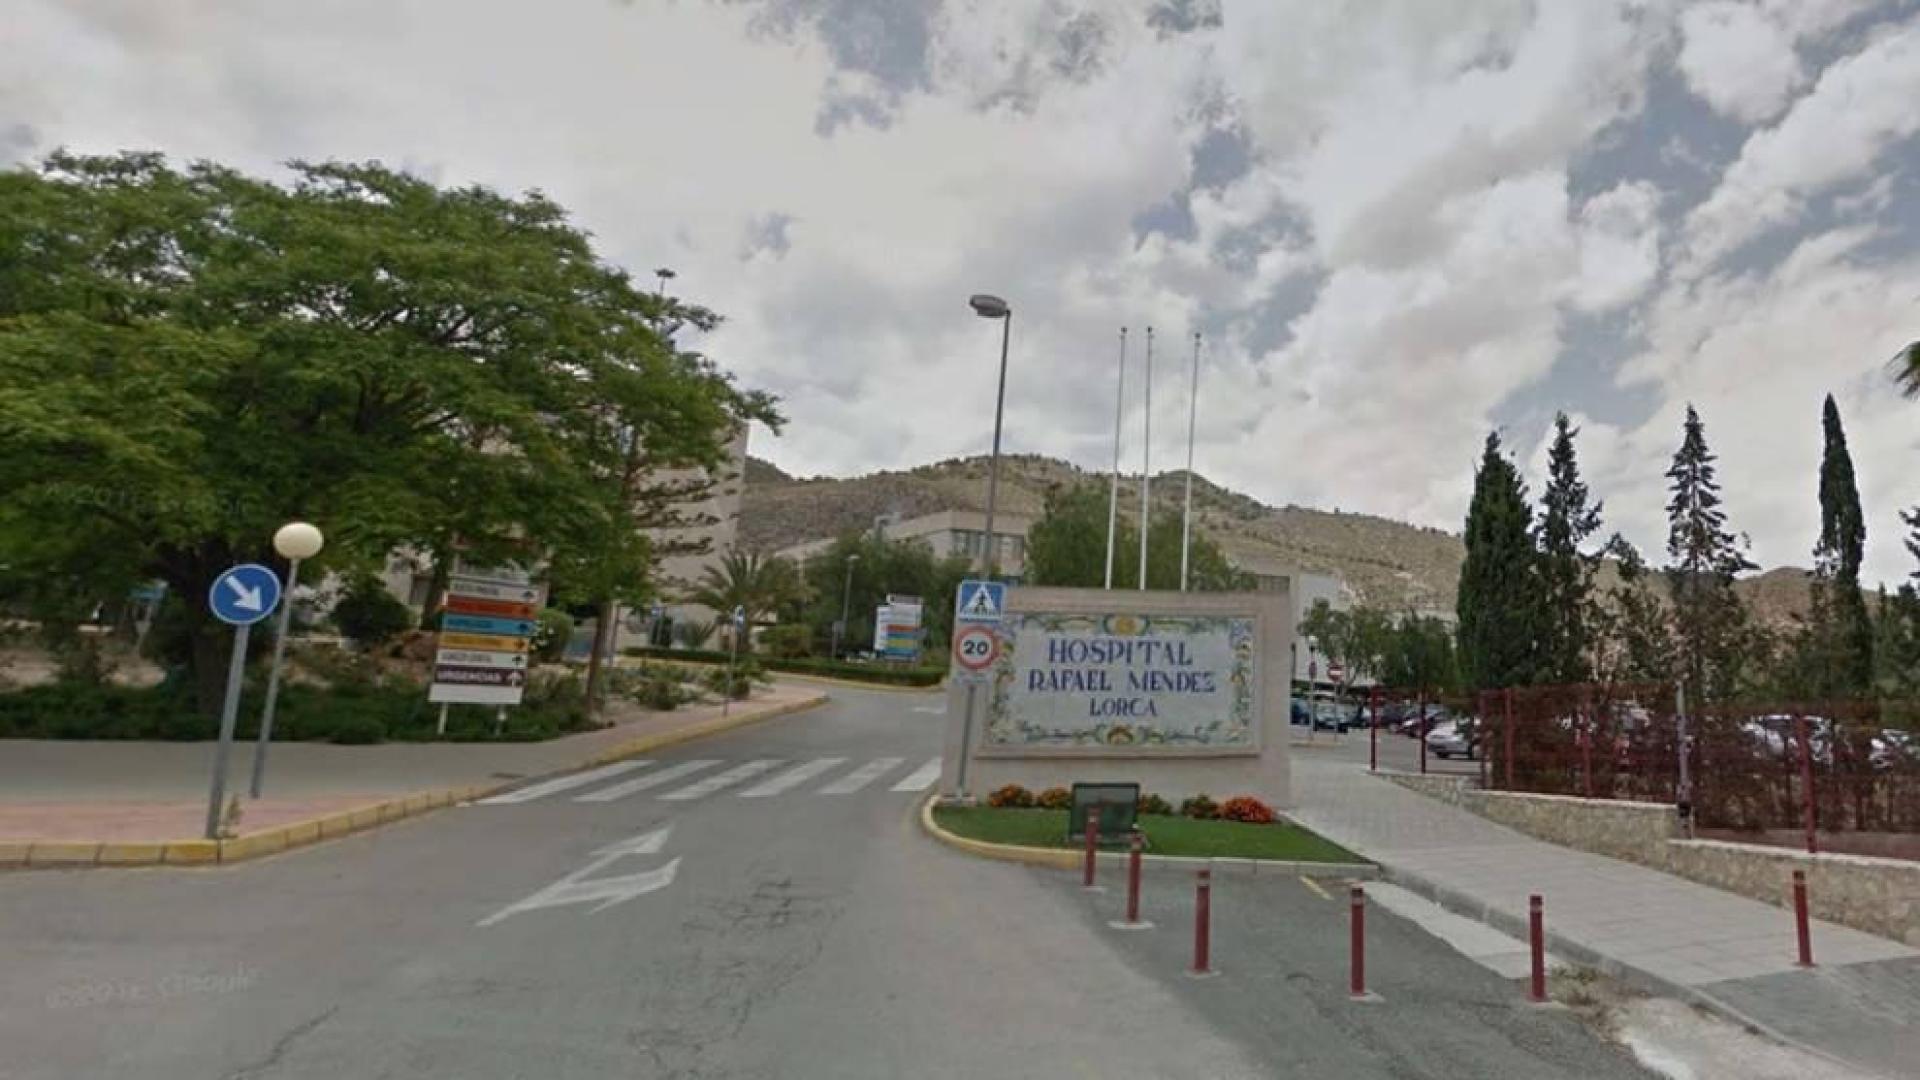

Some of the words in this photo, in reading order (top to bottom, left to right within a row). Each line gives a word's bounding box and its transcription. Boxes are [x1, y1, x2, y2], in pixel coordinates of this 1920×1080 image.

[963, 640, 989, 656] 20
[1048, 638, 1194, 666] HOSPITAL
[1028, 668, 1113, 692] RAFAEL
[1128, 670, 1217, 693] MENDEZ
[1089, 697, 1159, 717] LORCA
